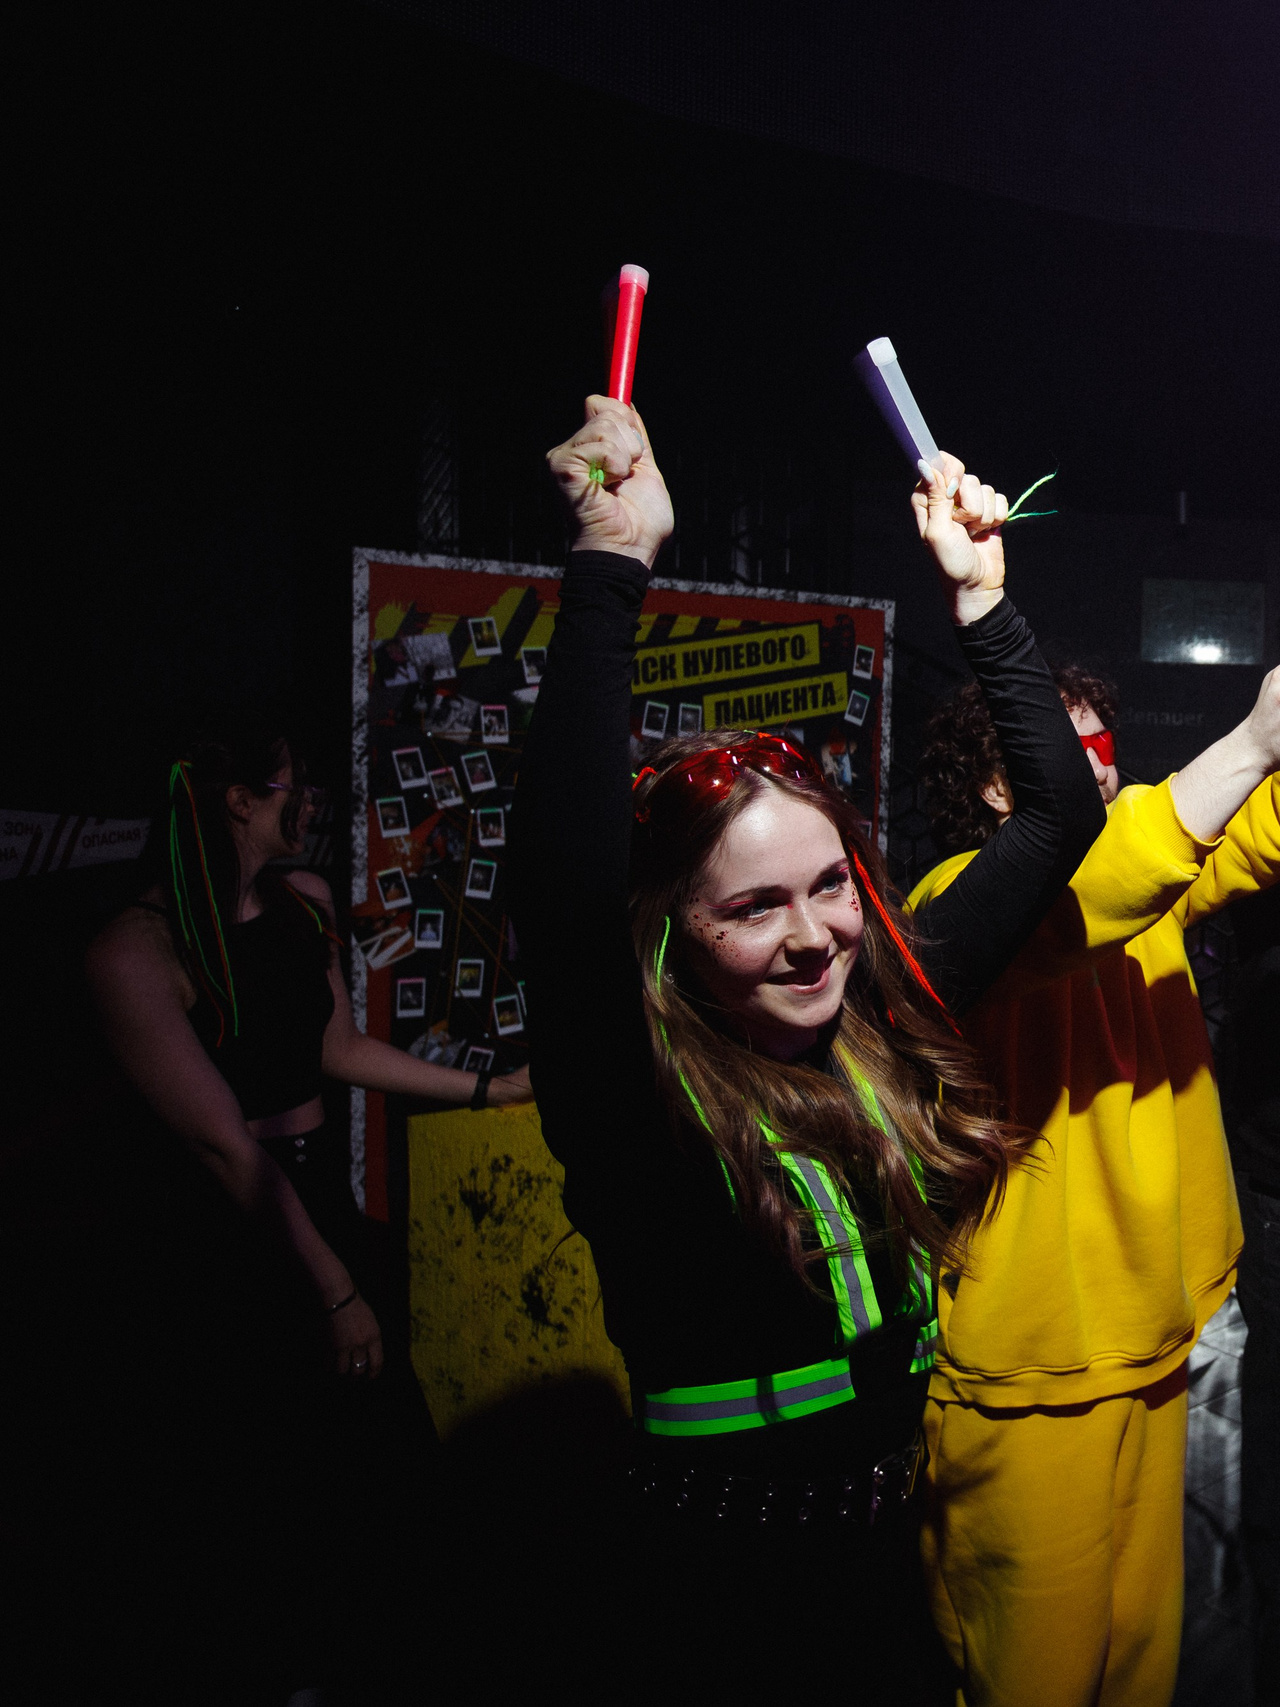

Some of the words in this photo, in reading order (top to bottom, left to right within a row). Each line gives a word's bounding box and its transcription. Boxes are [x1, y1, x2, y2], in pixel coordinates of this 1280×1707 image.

[683, 634, 805, 678] НУЛЕВОГО
[715, 681, 836, 725] ПАЦИЕНТА
[82, 827, 141, 849] ОПАСНАЯ
